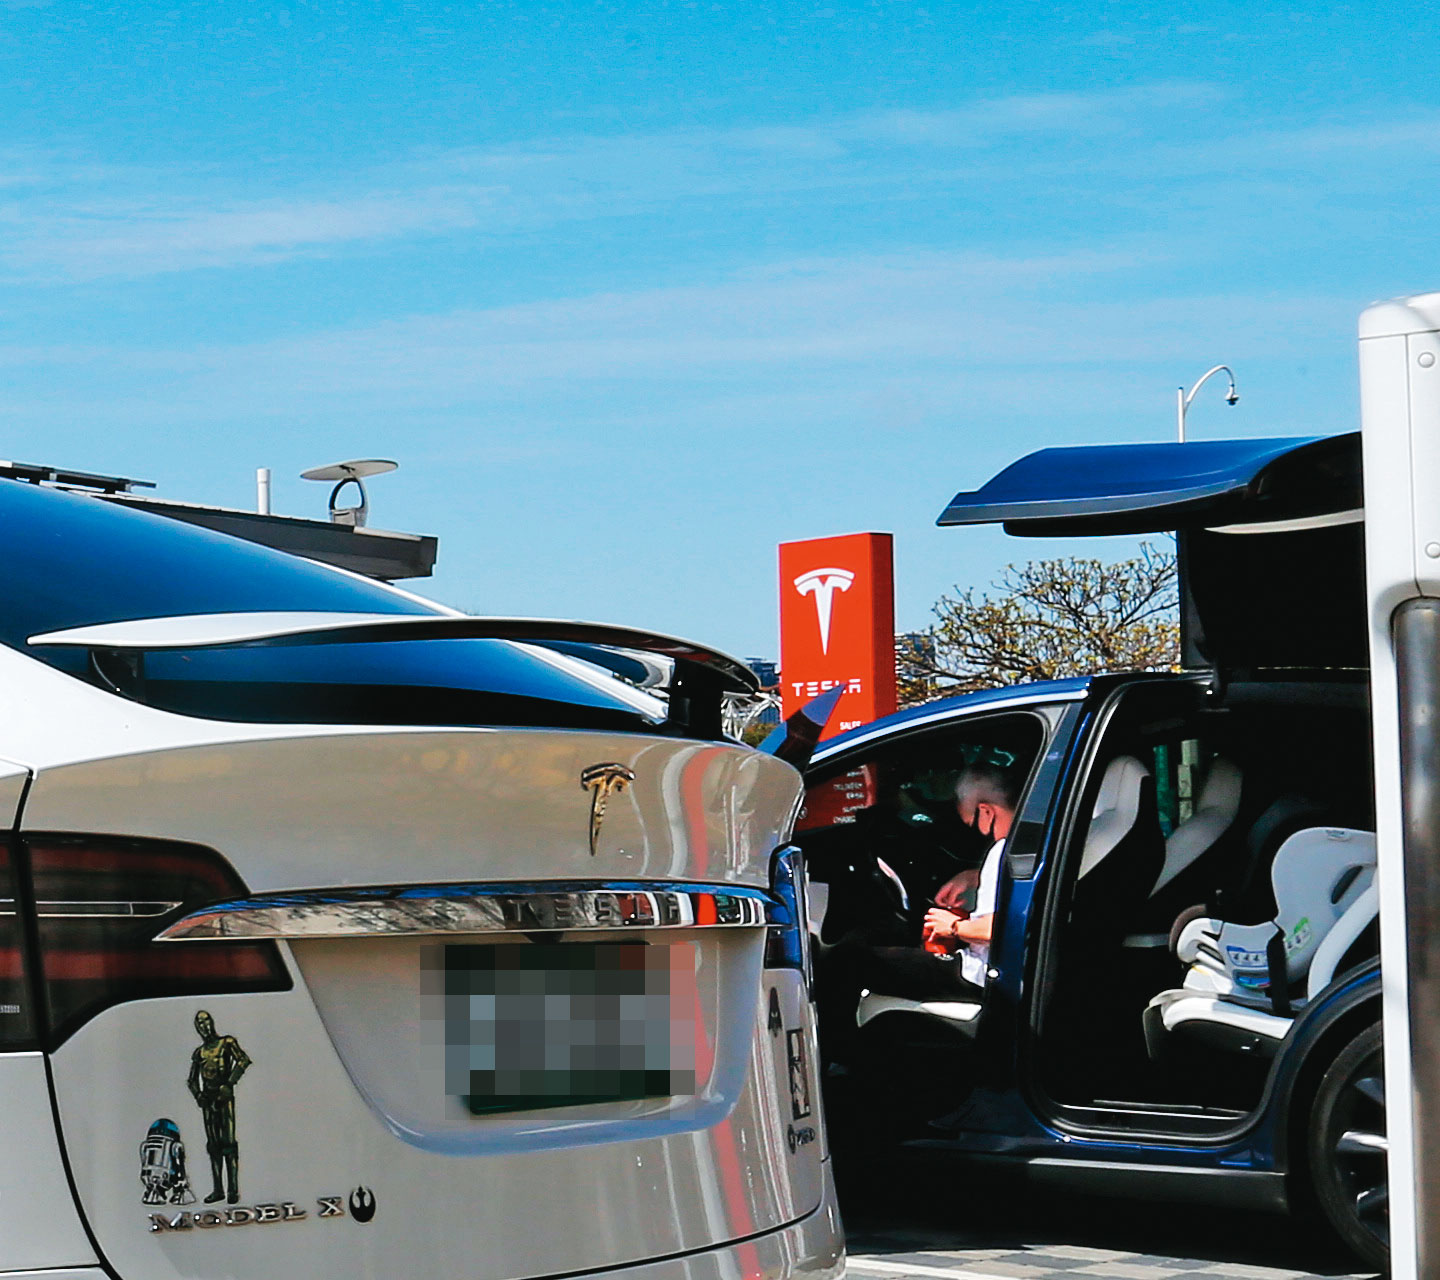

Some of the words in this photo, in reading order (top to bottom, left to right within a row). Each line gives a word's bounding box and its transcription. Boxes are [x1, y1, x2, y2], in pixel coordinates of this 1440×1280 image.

[506, 892, 682, 923] TESLA
[148, 1202, 308, 1233] MODEL
[316, 1196, 345, 1217] X
